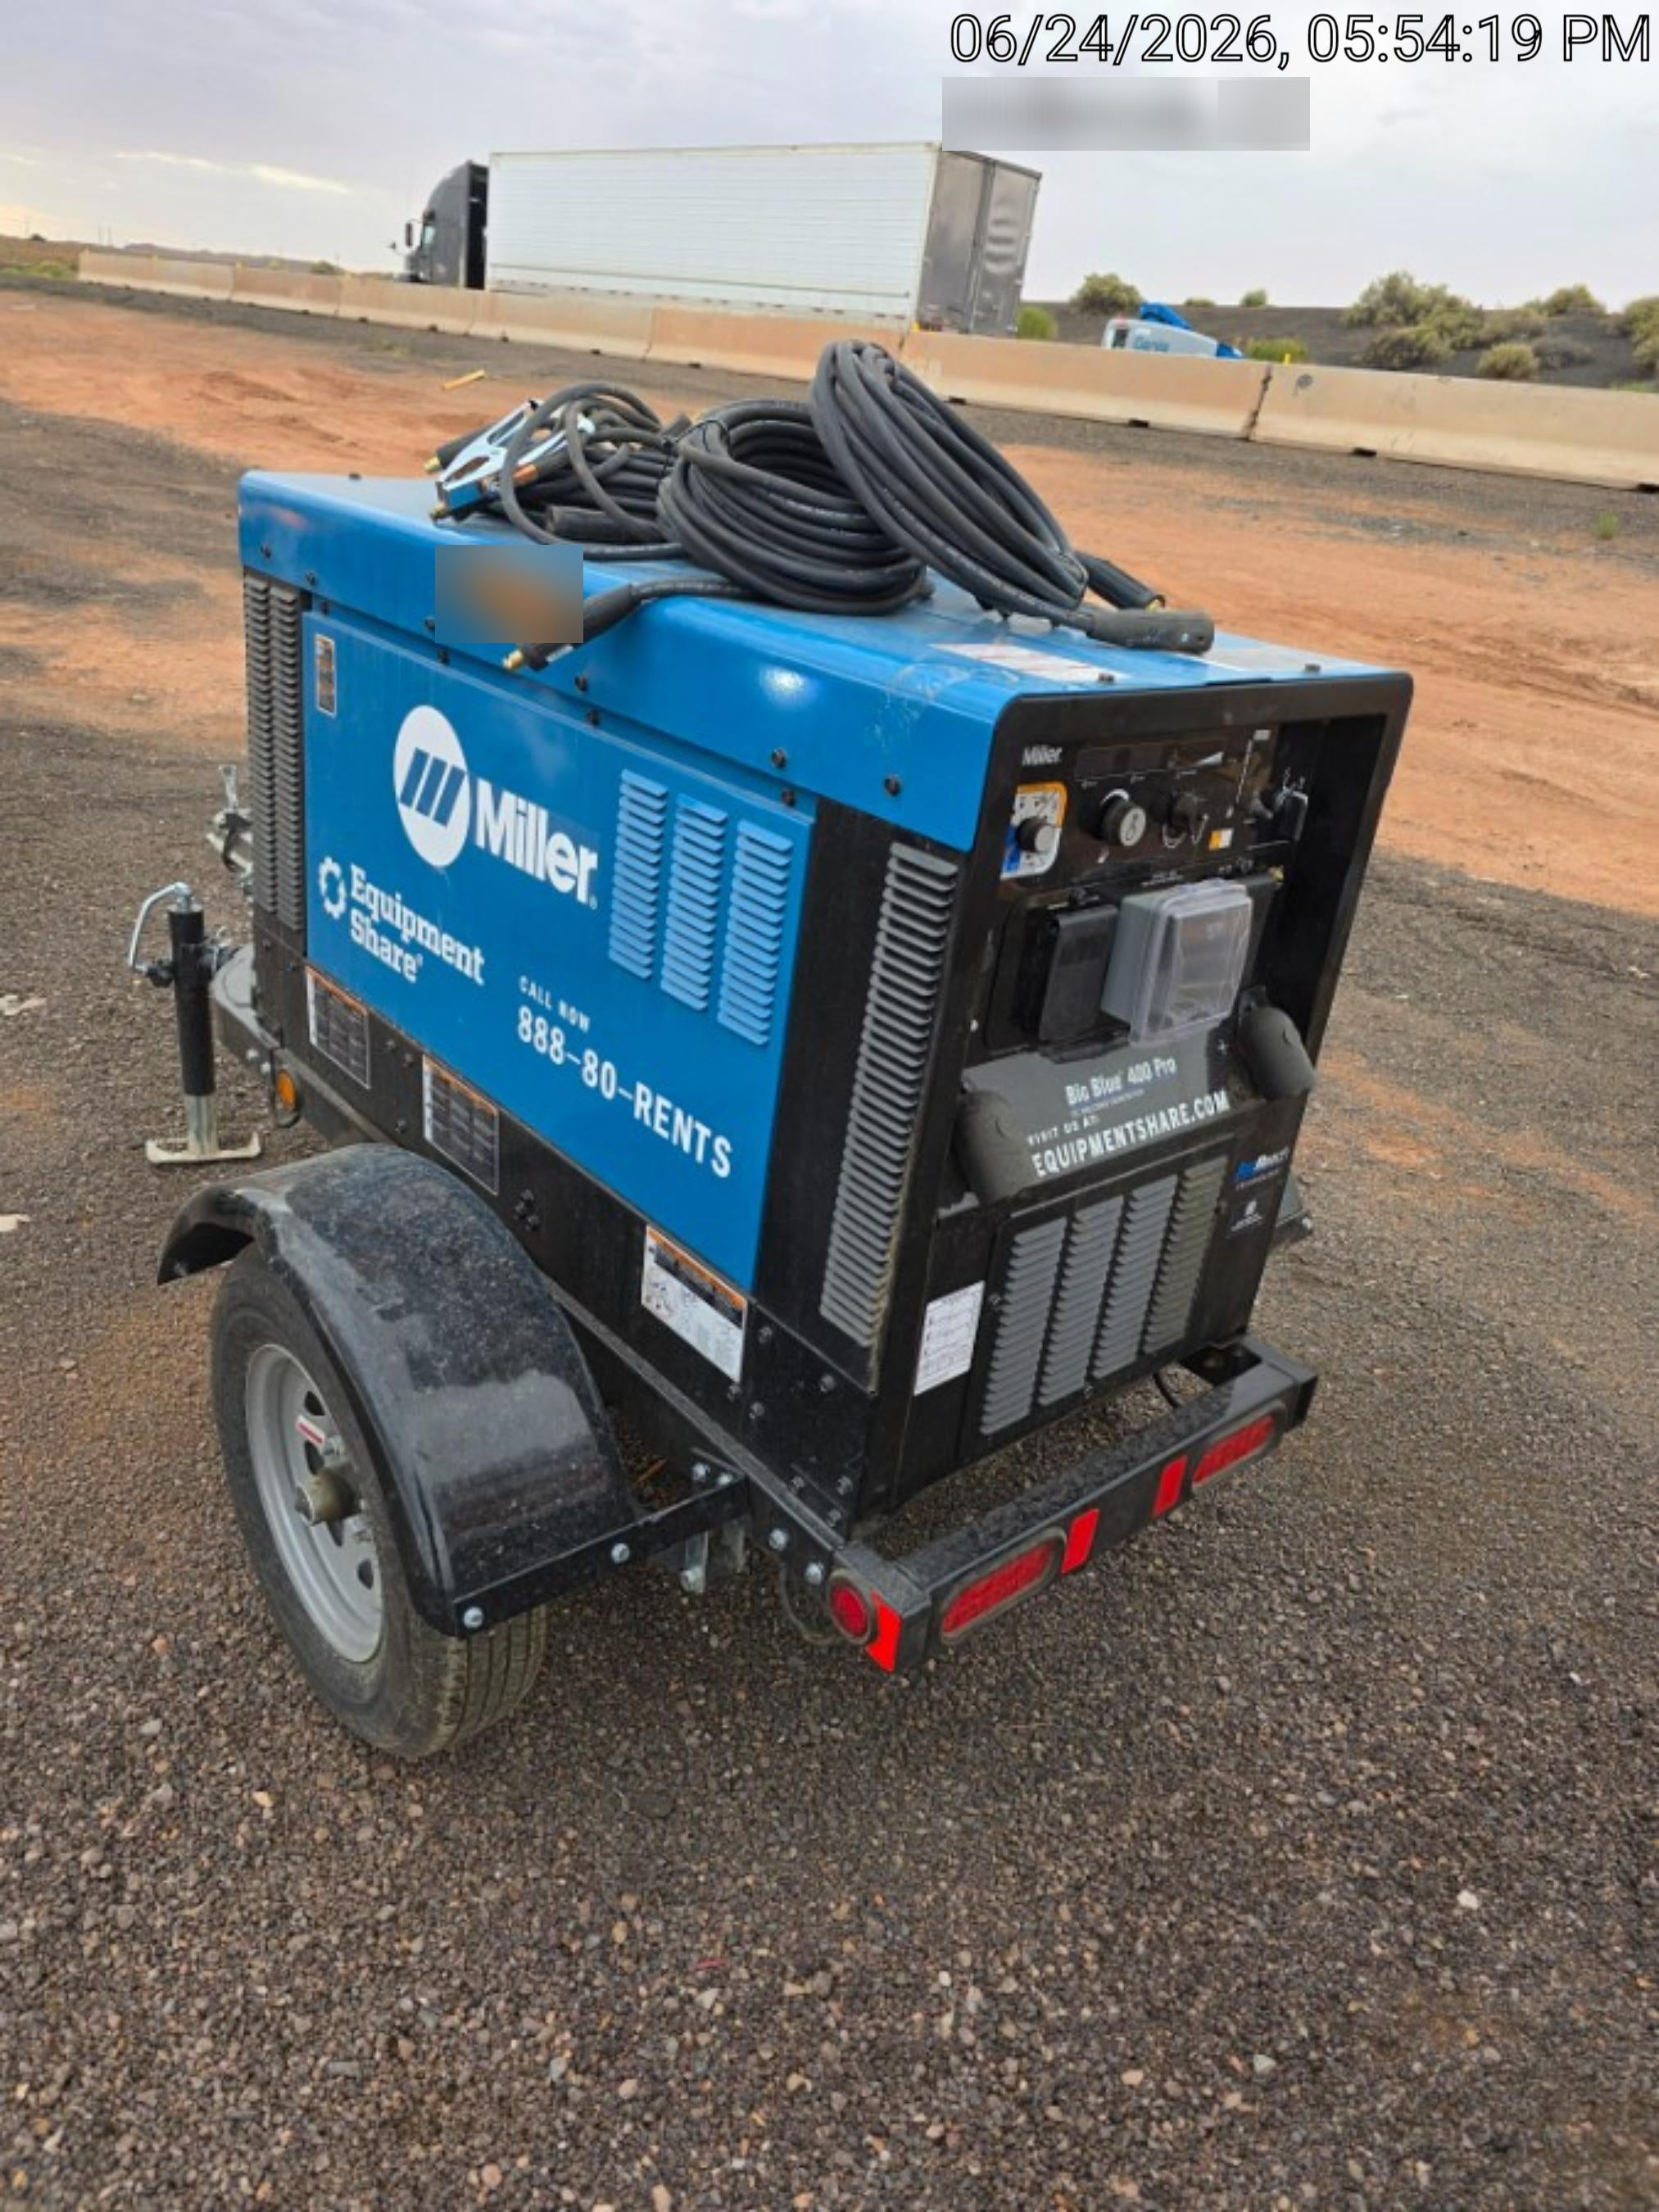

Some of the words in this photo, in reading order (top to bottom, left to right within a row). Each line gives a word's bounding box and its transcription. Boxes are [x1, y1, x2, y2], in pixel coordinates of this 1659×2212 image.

[1022, 744, 1063, 767] Miller
[474, 777, 598, 904] Miller
[350, 862, 485, 986] Equipment
[519, 975, 552, 1010] CALL
[558, 999, 591, 1034] NOW
[517, 1004, 732, 1179] 888-80-RENTS
[1065, 1084, 1090, 1107] Big
[1126, 1061, 1154, 1086] 400
[1152, 1055, 1178, 1079] Pro
[1030, 1087, 1231, 1179] EQUIPMENTSHARE.COM
